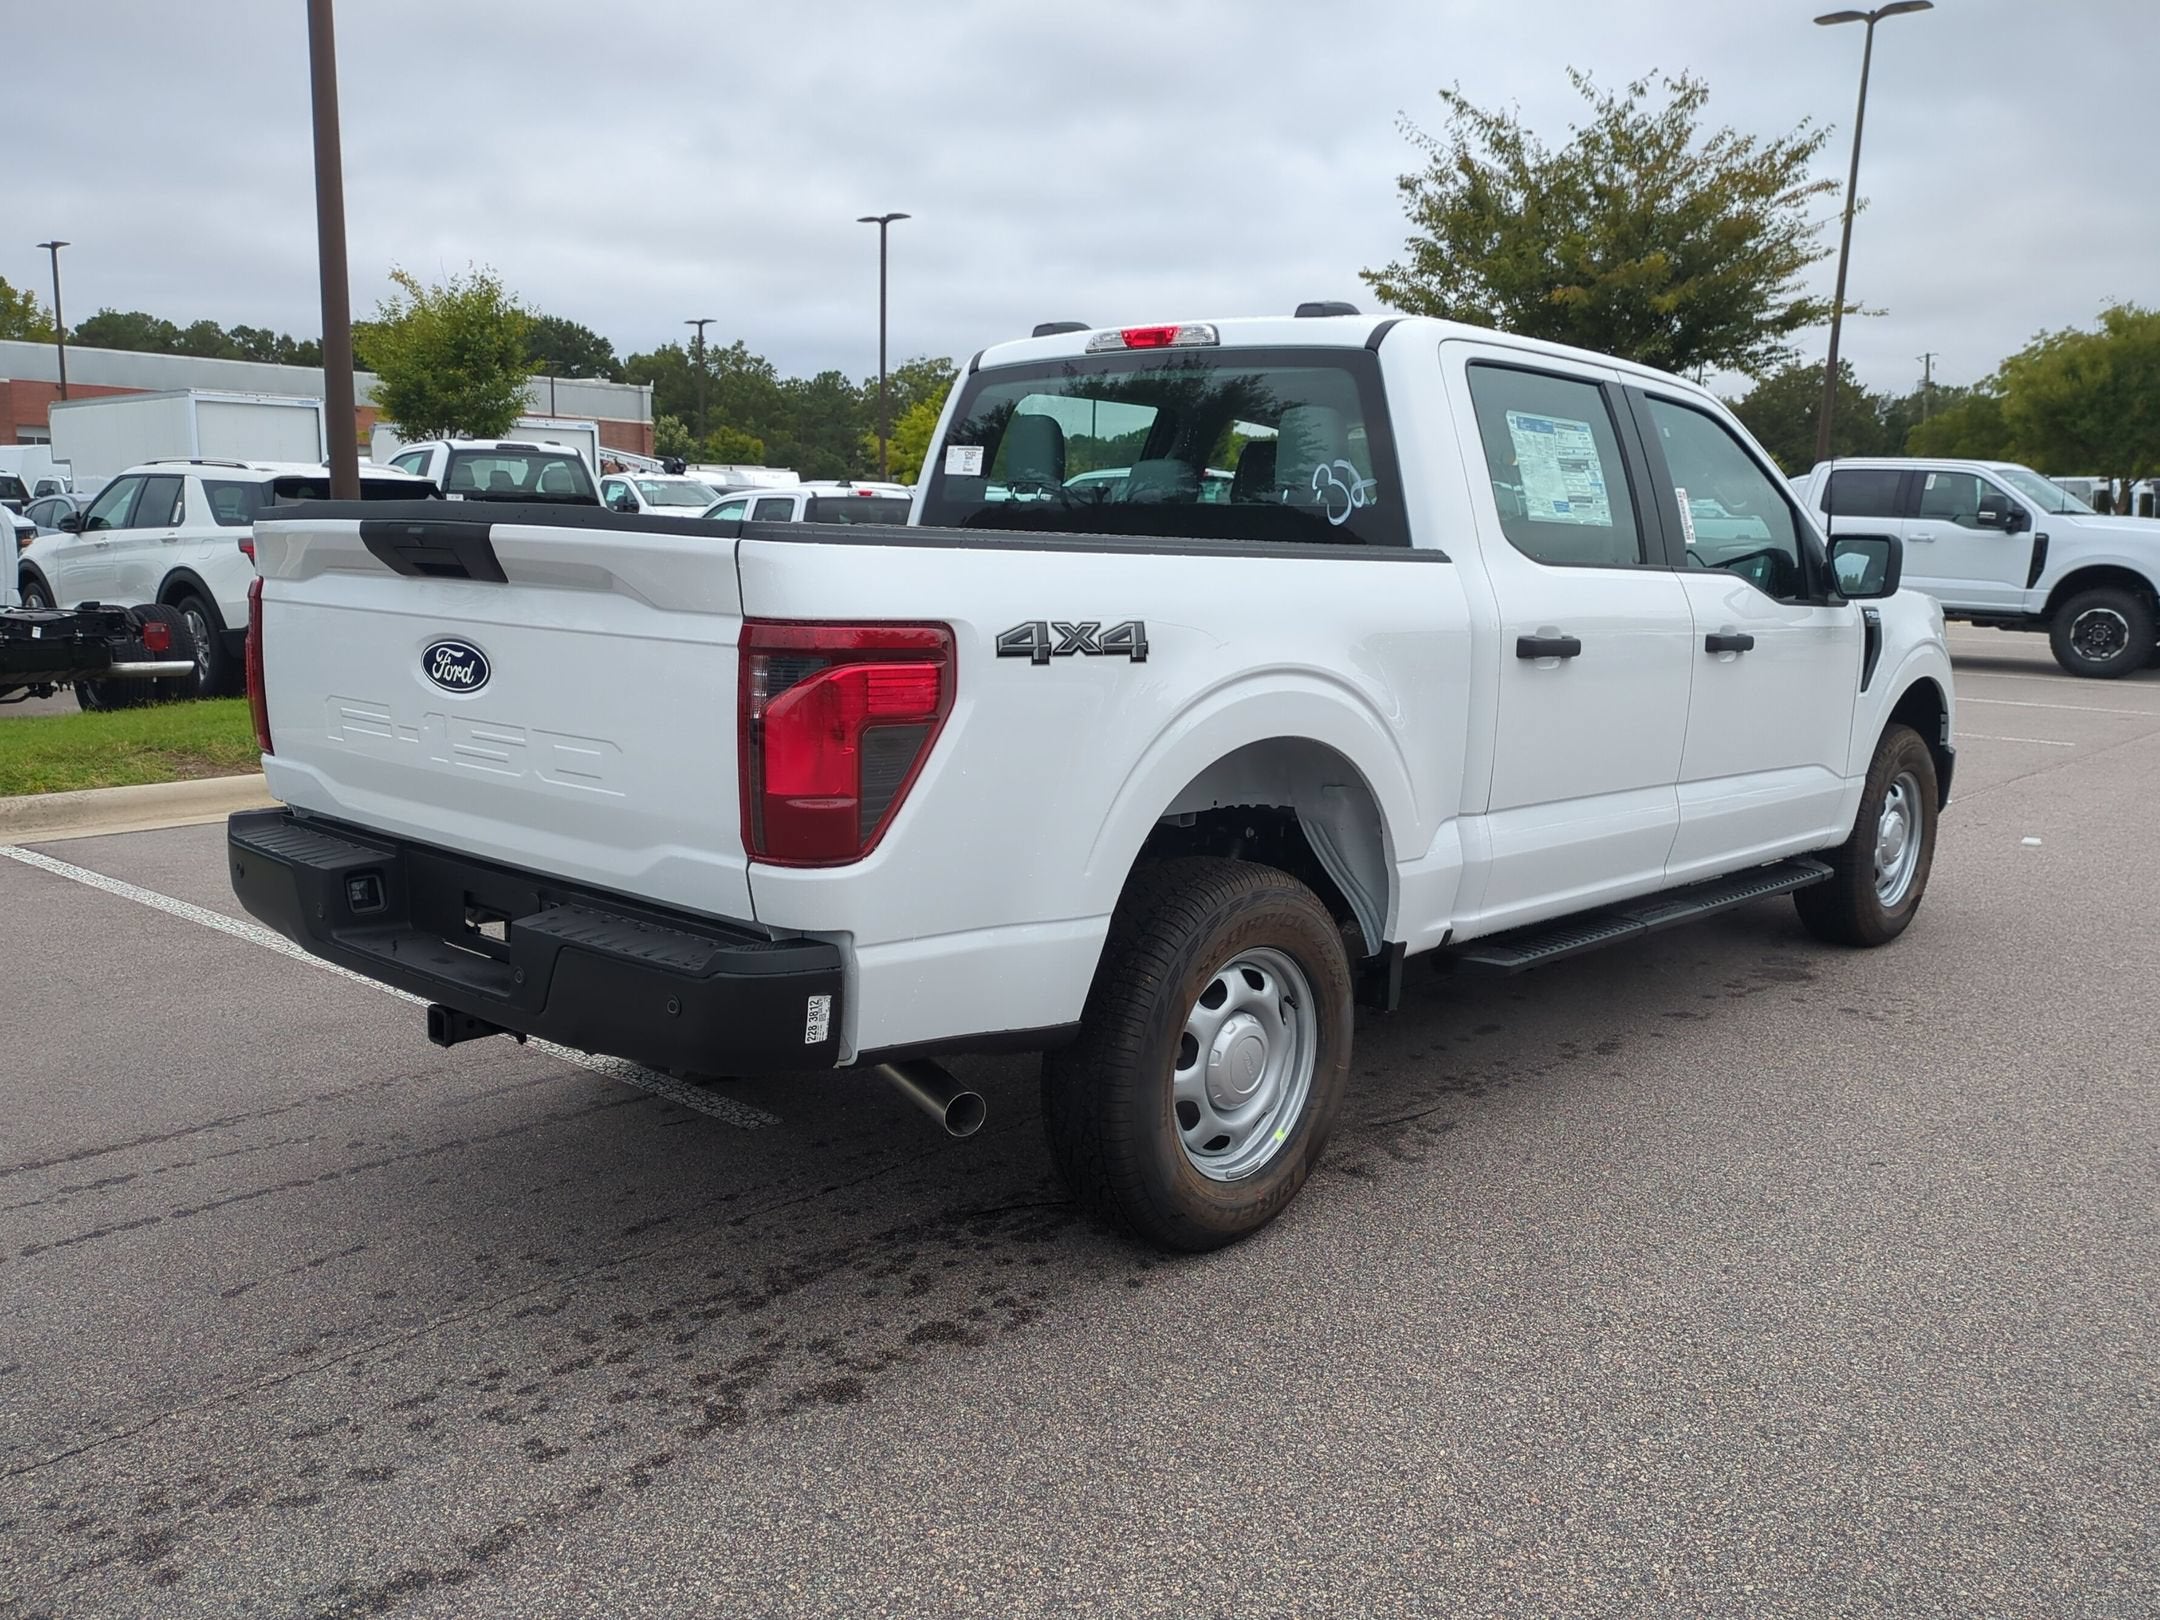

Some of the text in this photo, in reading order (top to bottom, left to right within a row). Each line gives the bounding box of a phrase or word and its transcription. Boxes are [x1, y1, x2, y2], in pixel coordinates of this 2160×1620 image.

[432, 647, 476, 685] Ford
[807, 999, 819, 1042] 228 3812
